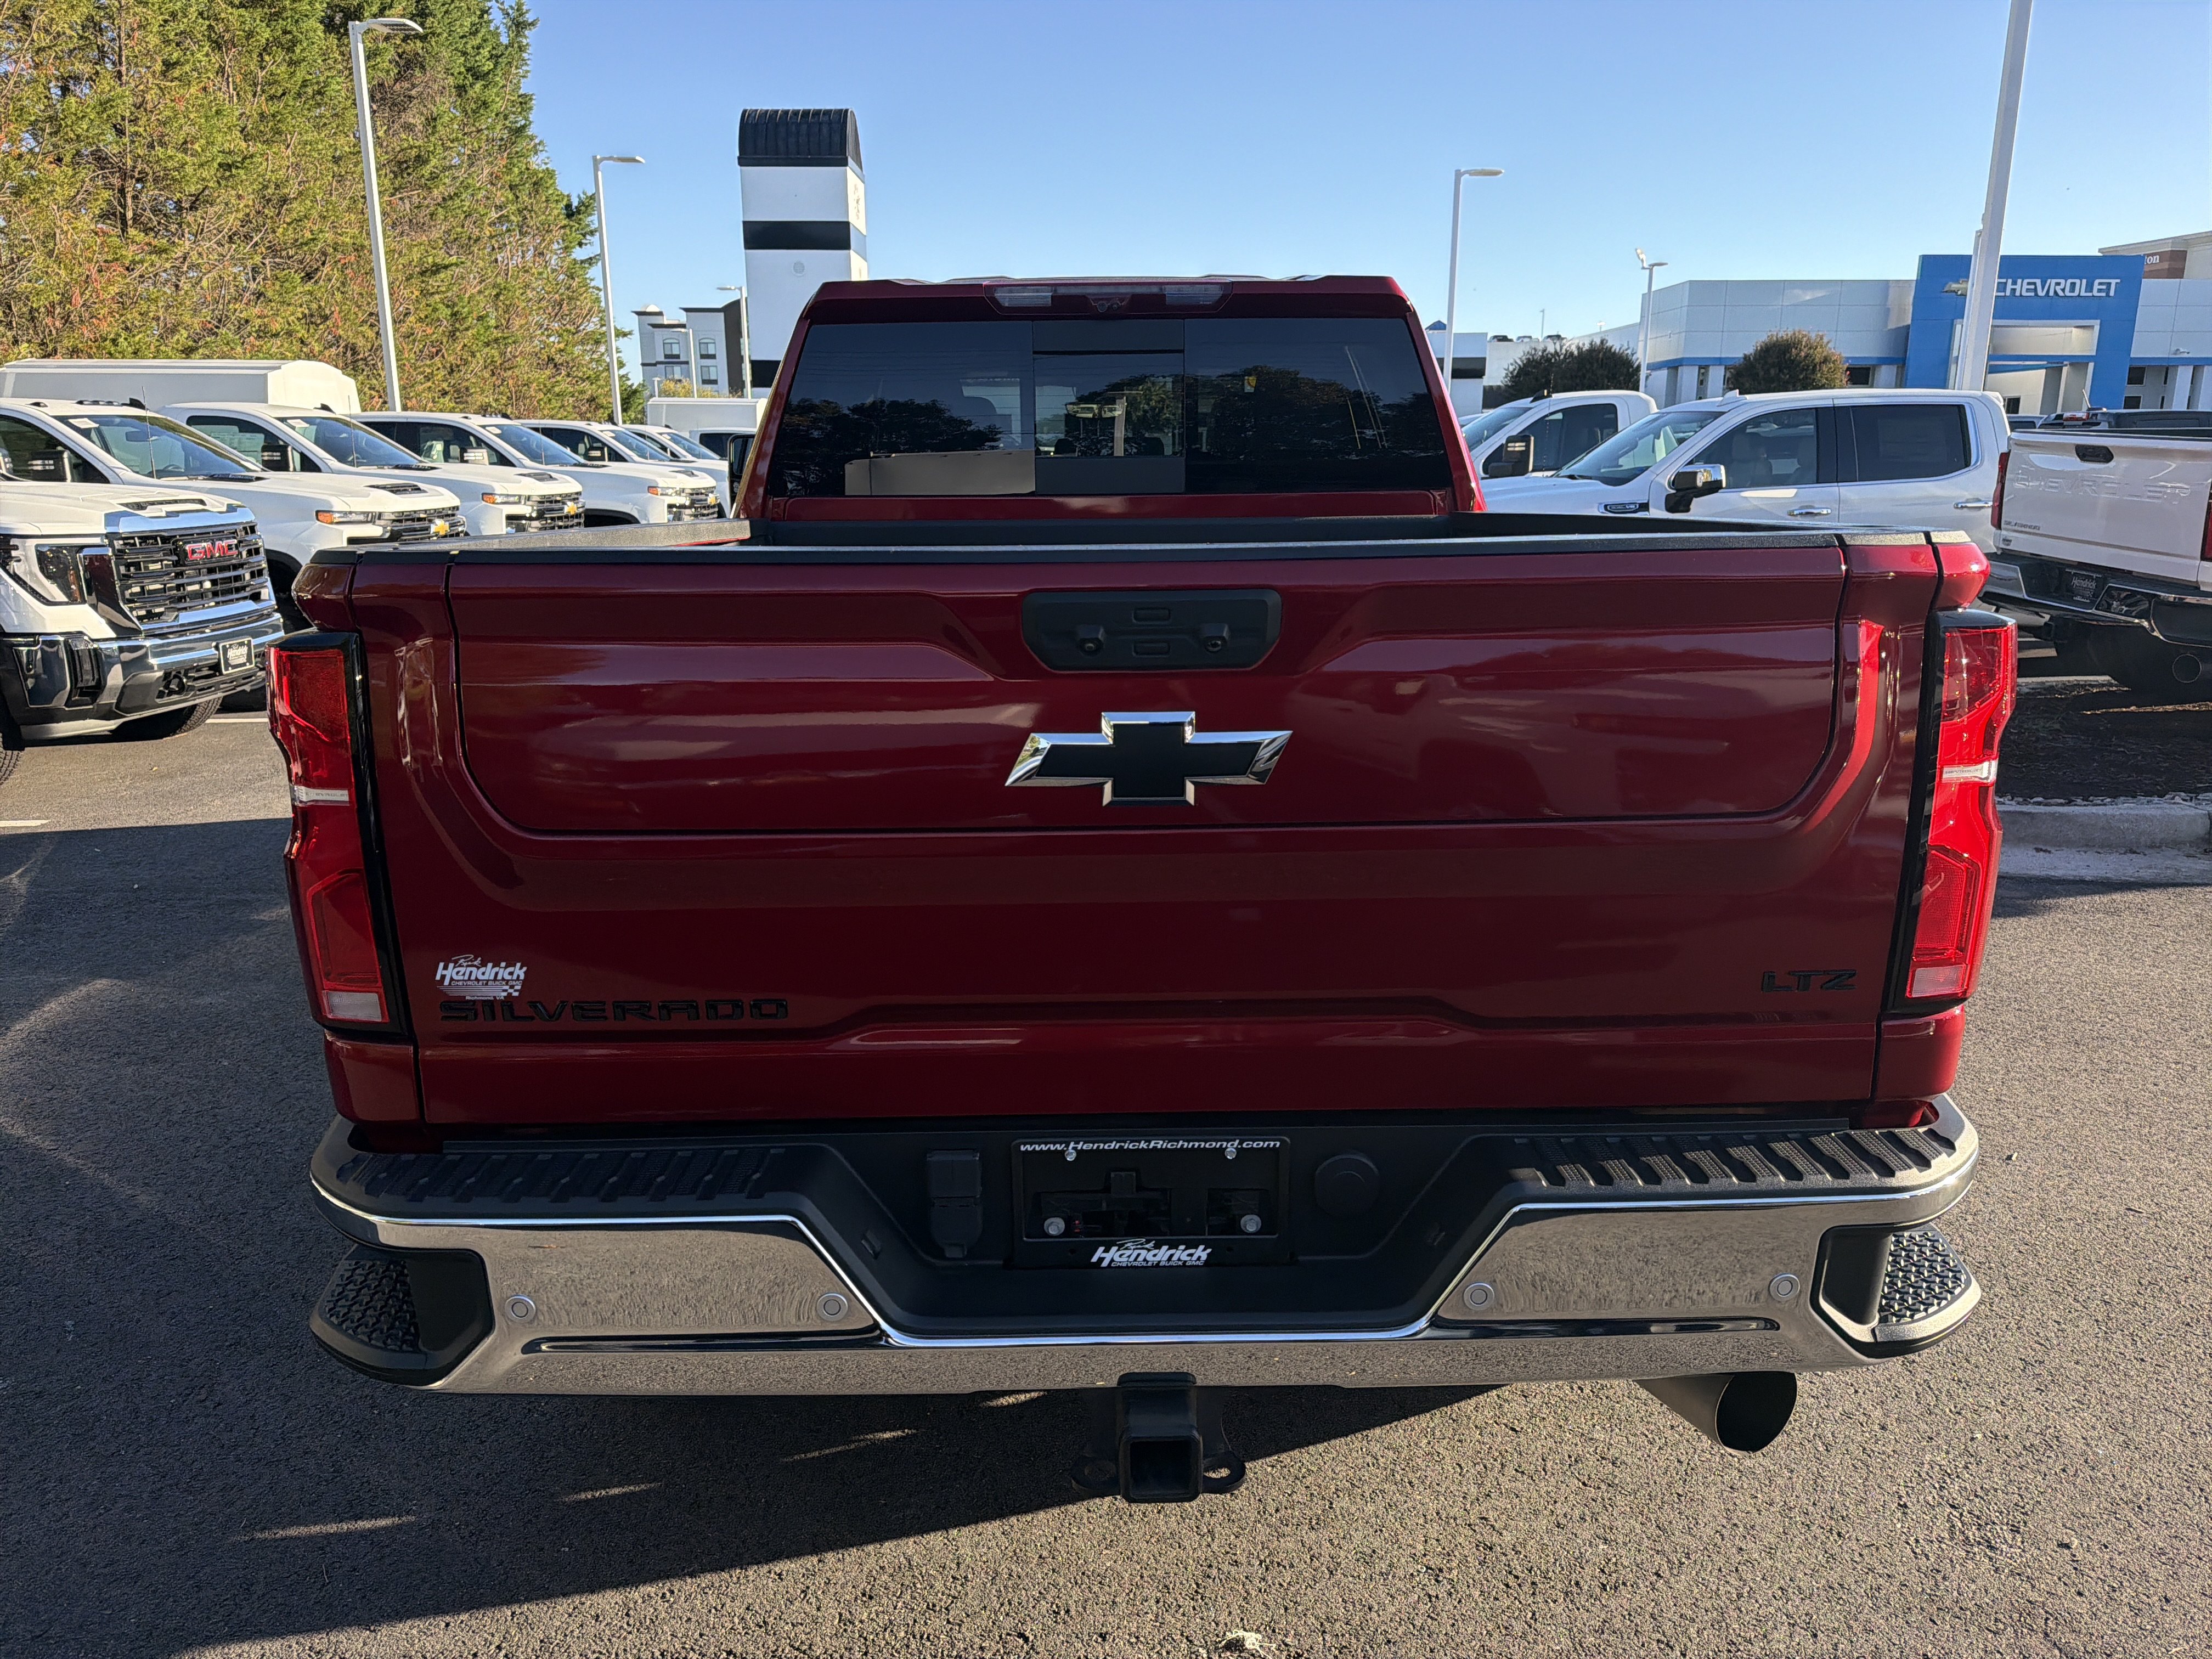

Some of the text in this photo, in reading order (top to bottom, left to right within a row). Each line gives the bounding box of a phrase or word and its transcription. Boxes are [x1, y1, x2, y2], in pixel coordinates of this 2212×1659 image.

[1996, 279, 2120, 296] CHEVROLET
[185, 539, 238, 560] GMC
[435, 962, 527, 986] Hendrick
[1762, 969, 1857, 992] LTZ
[440, 999, 788, 1022] SILVERADO
[1020, 1139, 1281, 1151] www.HendrickRichmond.com
[1090, 1245, 1212, 1267] Hendrick
